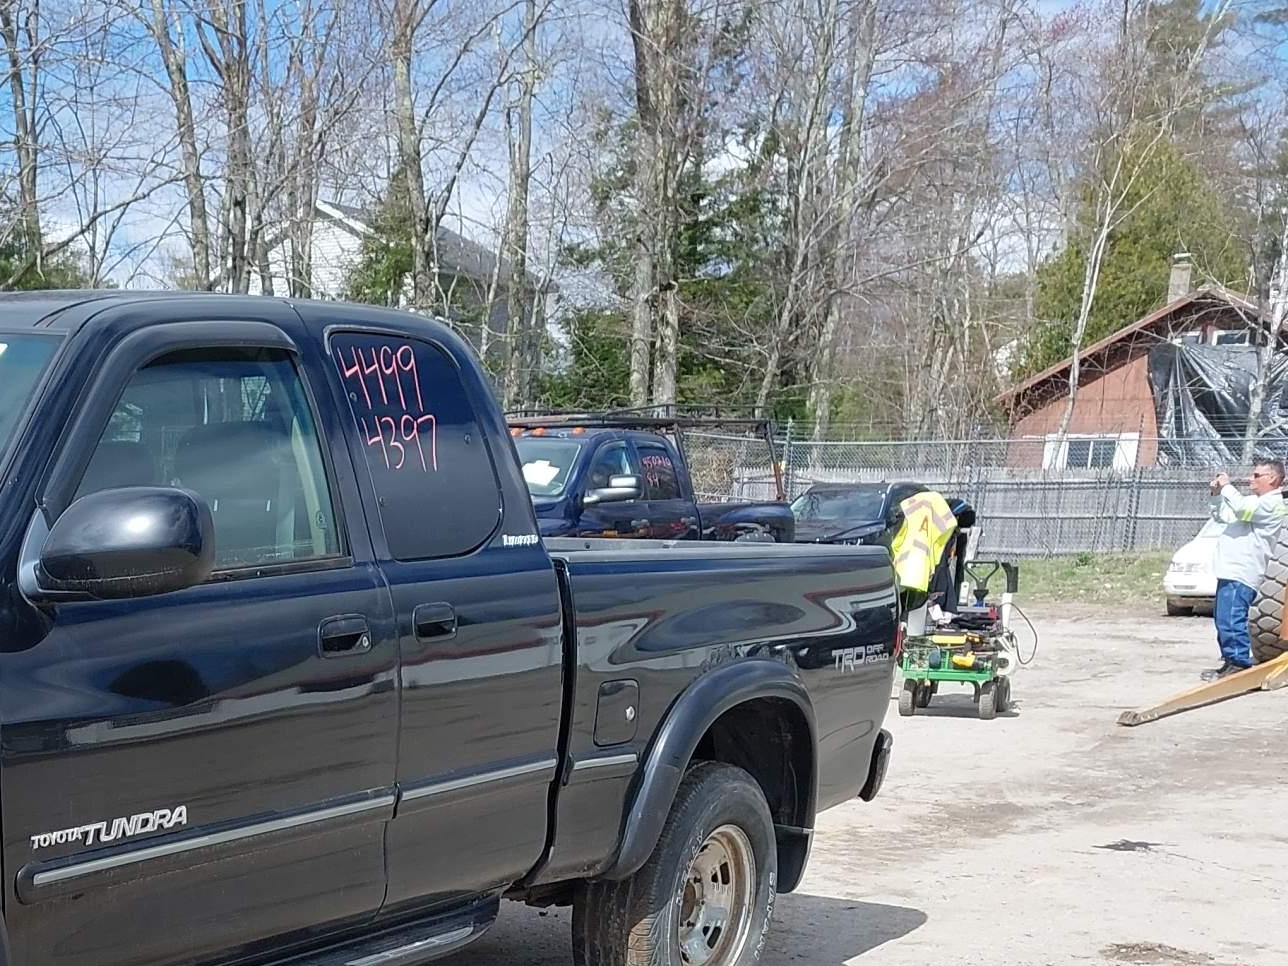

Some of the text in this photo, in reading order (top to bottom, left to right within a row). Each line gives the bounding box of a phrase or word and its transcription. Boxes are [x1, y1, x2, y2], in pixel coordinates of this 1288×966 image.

[336, 345, 424, 412] 4499
[360, 414, 438, 473] 4397
[832, 646, 866, 673] TRD
[865, 653, 889, 664] ROAD
[866, 643, 884, 654] OFF
[30, 805, 187, 849] TOYOTA TUNDRA
